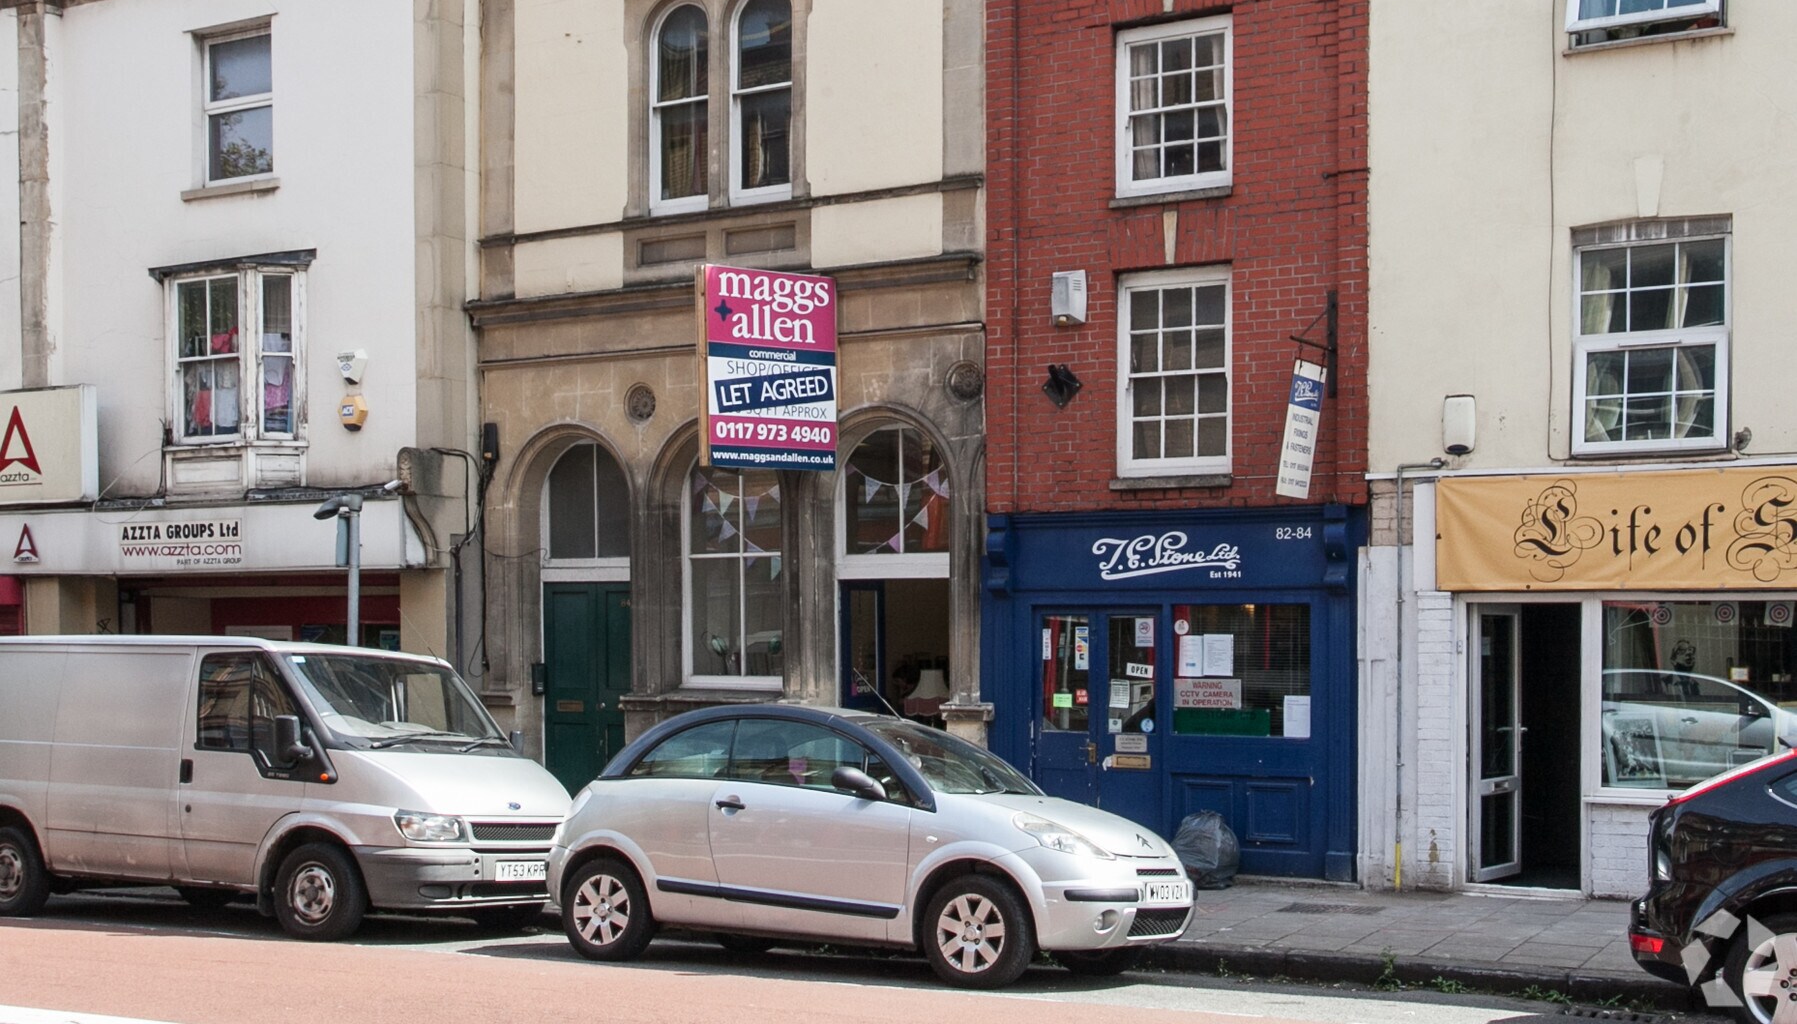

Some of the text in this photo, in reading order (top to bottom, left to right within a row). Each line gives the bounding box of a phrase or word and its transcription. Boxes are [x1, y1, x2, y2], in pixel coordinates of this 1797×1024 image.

[718, 271, 830, 315] maggs
[731, 303, 816, 344] allen
[748, 350, 797, 362] commercial
[720, 376, 829, 407] LET AGREED
[782, 405, 827, 419] APPROX
[716, 421, 831, 444] 0117 973 4940
[713, 450, 835, 465] www.maggsandallen.co.uk
[121, 521, 239, 541] AZZTA GROUPS Ltd
[1275, 527, 1312, 540] 82-84
[1675, 503, 1725, 571] of
[121, 543, 242, 557] www.azzta.com
[176, 558, 192, 566] PART
[1209, 570, 1242, 579] Est 1941
[1130, 665, 1149, 676] OPEN
[1192, 681, 1223, 690] WARNING
[1179, 690, 1233, 699] CCTV CAMERA
[1192, 698, 1233, 707] OPERATION
[501, 864, 525, 877] YT53
